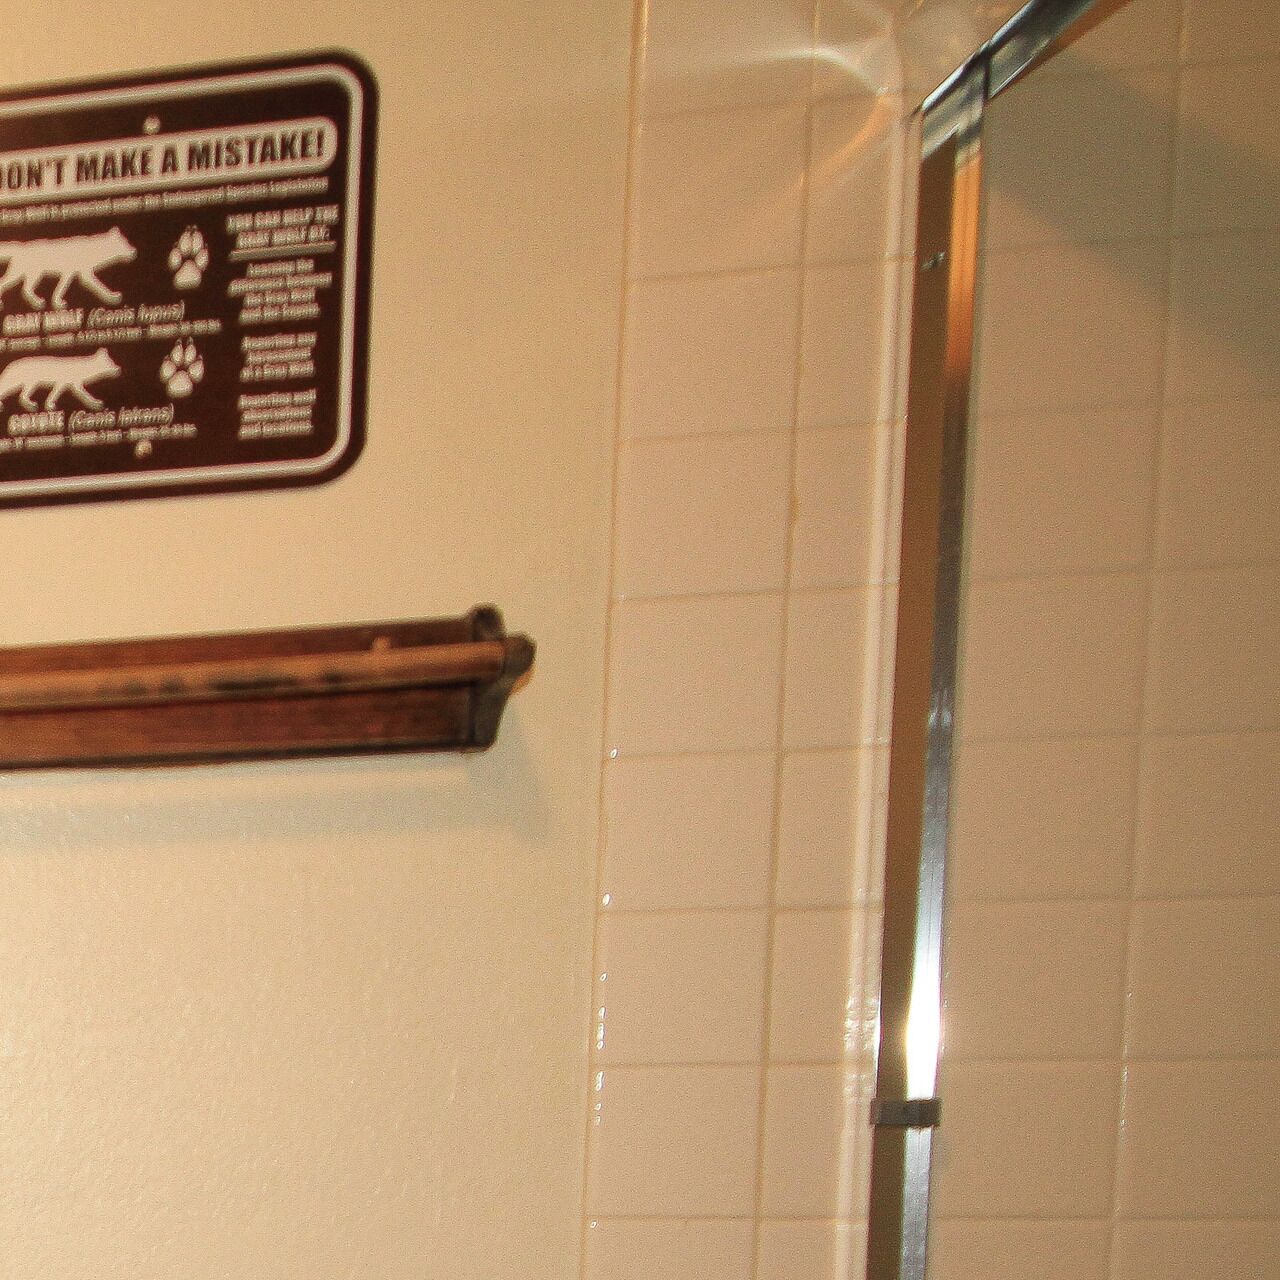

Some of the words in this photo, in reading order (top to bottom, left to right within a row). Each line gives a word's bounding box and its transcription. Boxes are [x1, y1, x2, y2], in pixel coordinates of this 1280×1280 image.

[76, 145, 152, 184] MAKE
[161, 143, 180, 175] A
[188, 129, 326, 171] MISTAKE!
[86, 305, 135, 329] (Canis
[7, 410, 65, 436] COYOTE
[68, 409, 116, 433] (Canis
